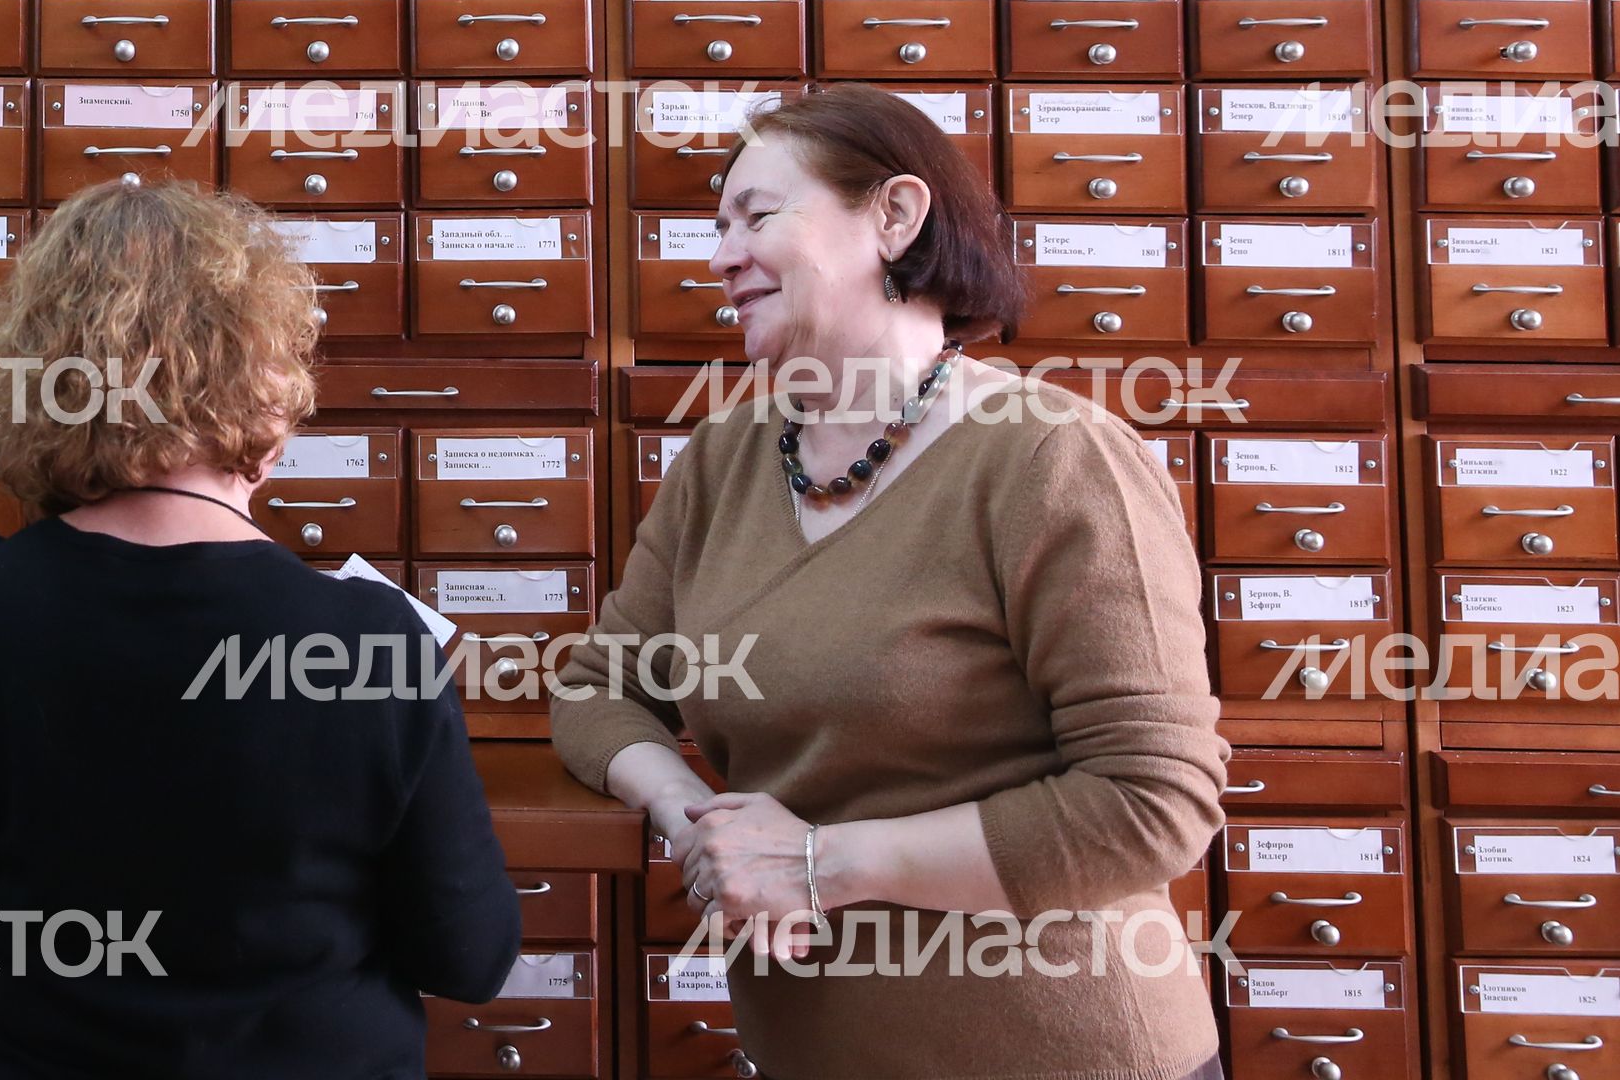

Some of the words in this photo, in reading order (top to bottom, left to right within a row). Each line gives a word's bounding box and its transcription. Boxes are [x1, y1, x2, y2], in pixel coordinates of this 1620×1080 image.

[171, 109, 190, 117] 1750
[440, 230, 482, 238] Западный
[1328, 248, 1347, 256] 1811
[542, 460, 560, 468] 1772
[545, 592, 566, 601] 1773
[1256, 840, 1294, 850] Зефиров
